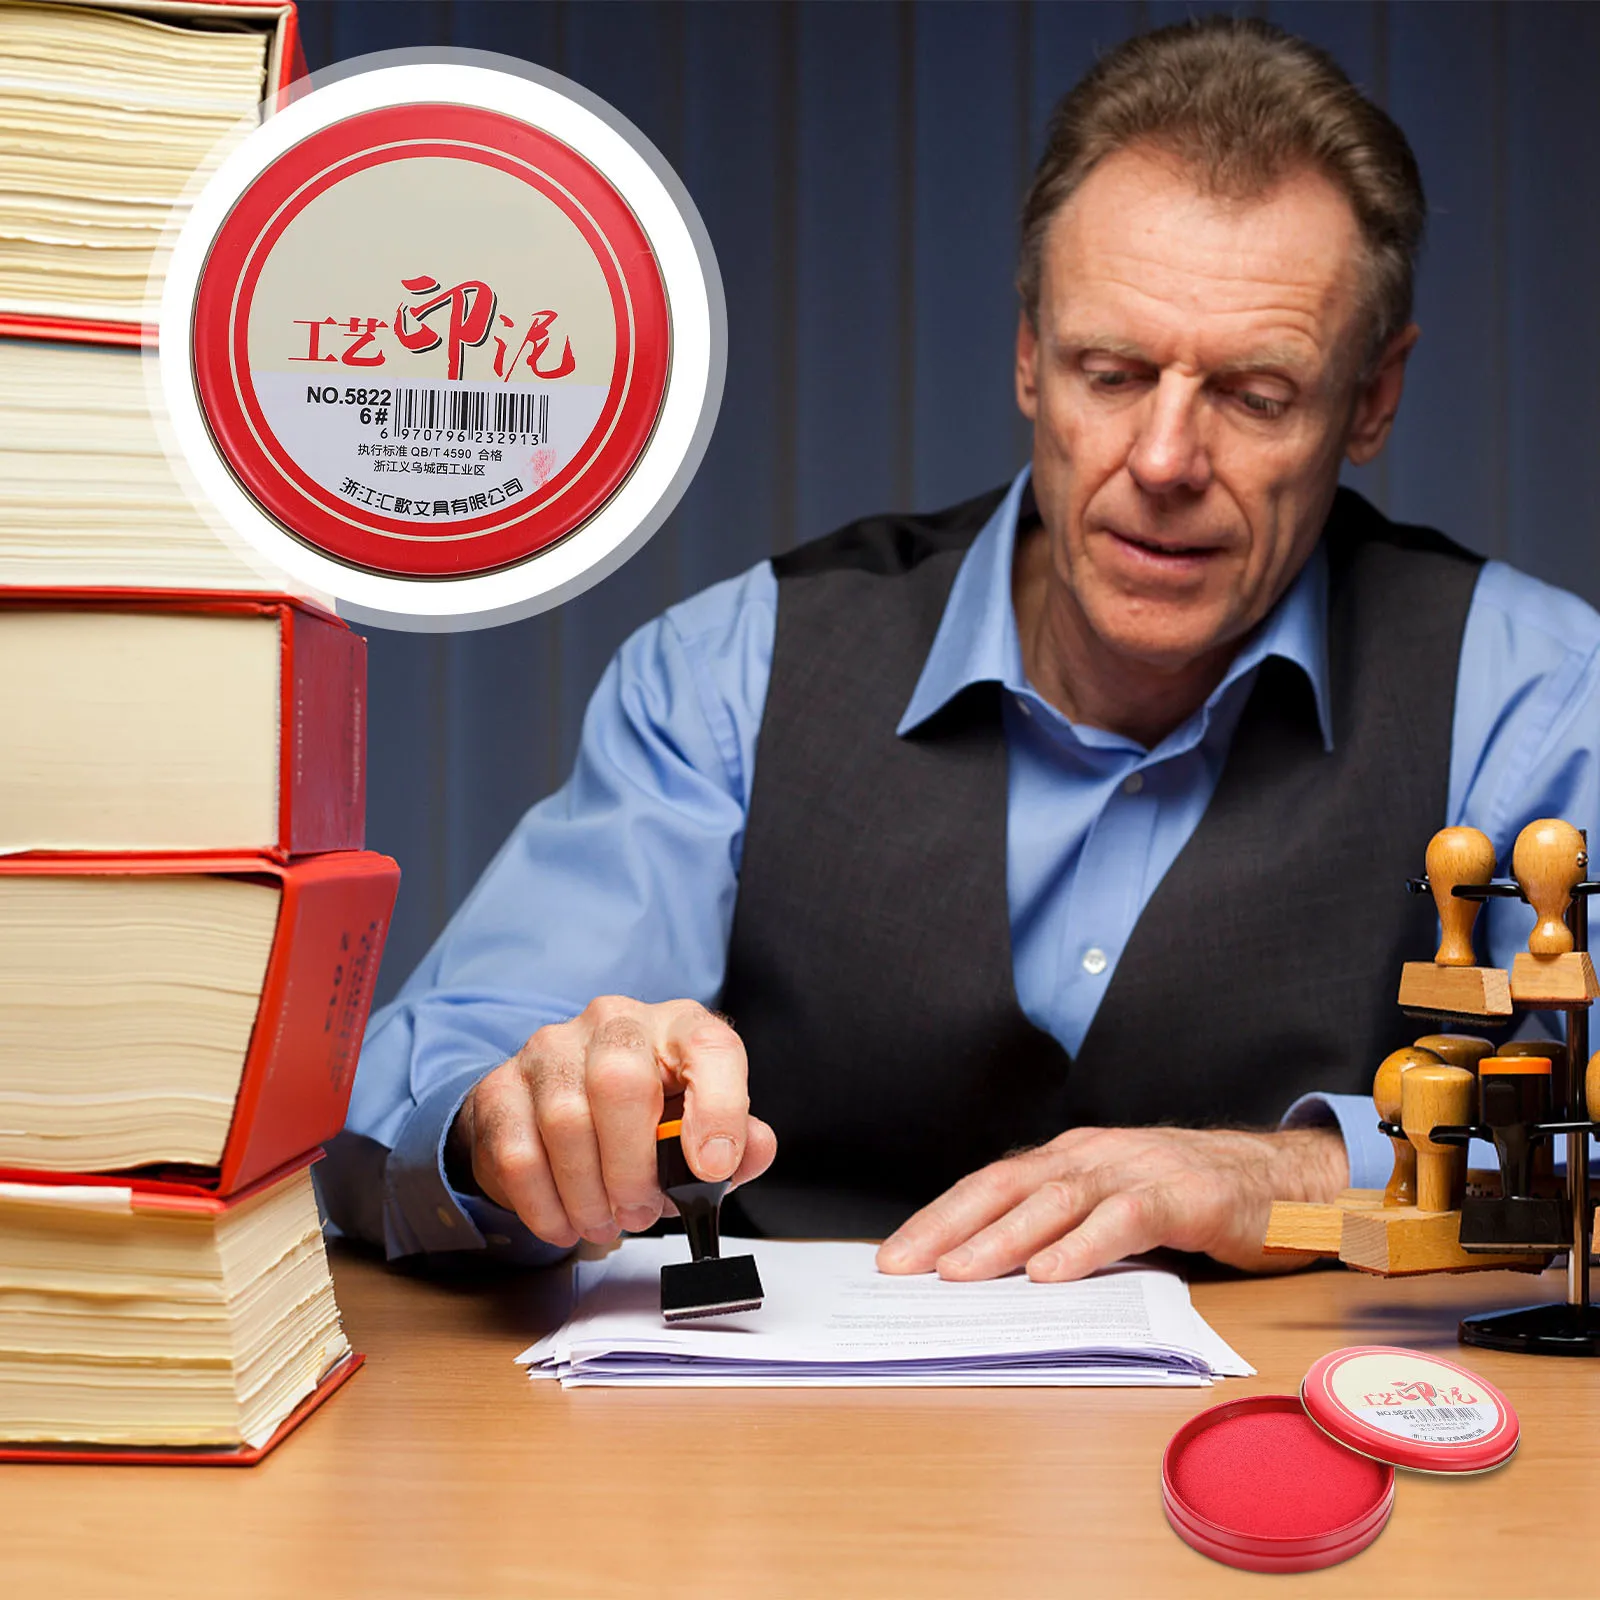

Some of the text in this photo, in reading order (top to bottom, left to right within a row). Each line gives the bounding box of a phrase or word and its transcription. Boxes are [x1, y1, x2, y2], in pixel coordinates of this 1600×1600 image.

[288, 275, 576, 382] 工艺印泥
[307, 387, 391, 406] NO.5822
[380, 428, 539, 446] 6 970796 232913
[358, 444, 502, 462] 执行标准 QB/T 4590 合格
[374, 460, 485, 476] 浙江义乌城西工业区
[340, 477, 523, 517] 浙江汇歌文具有限公司
